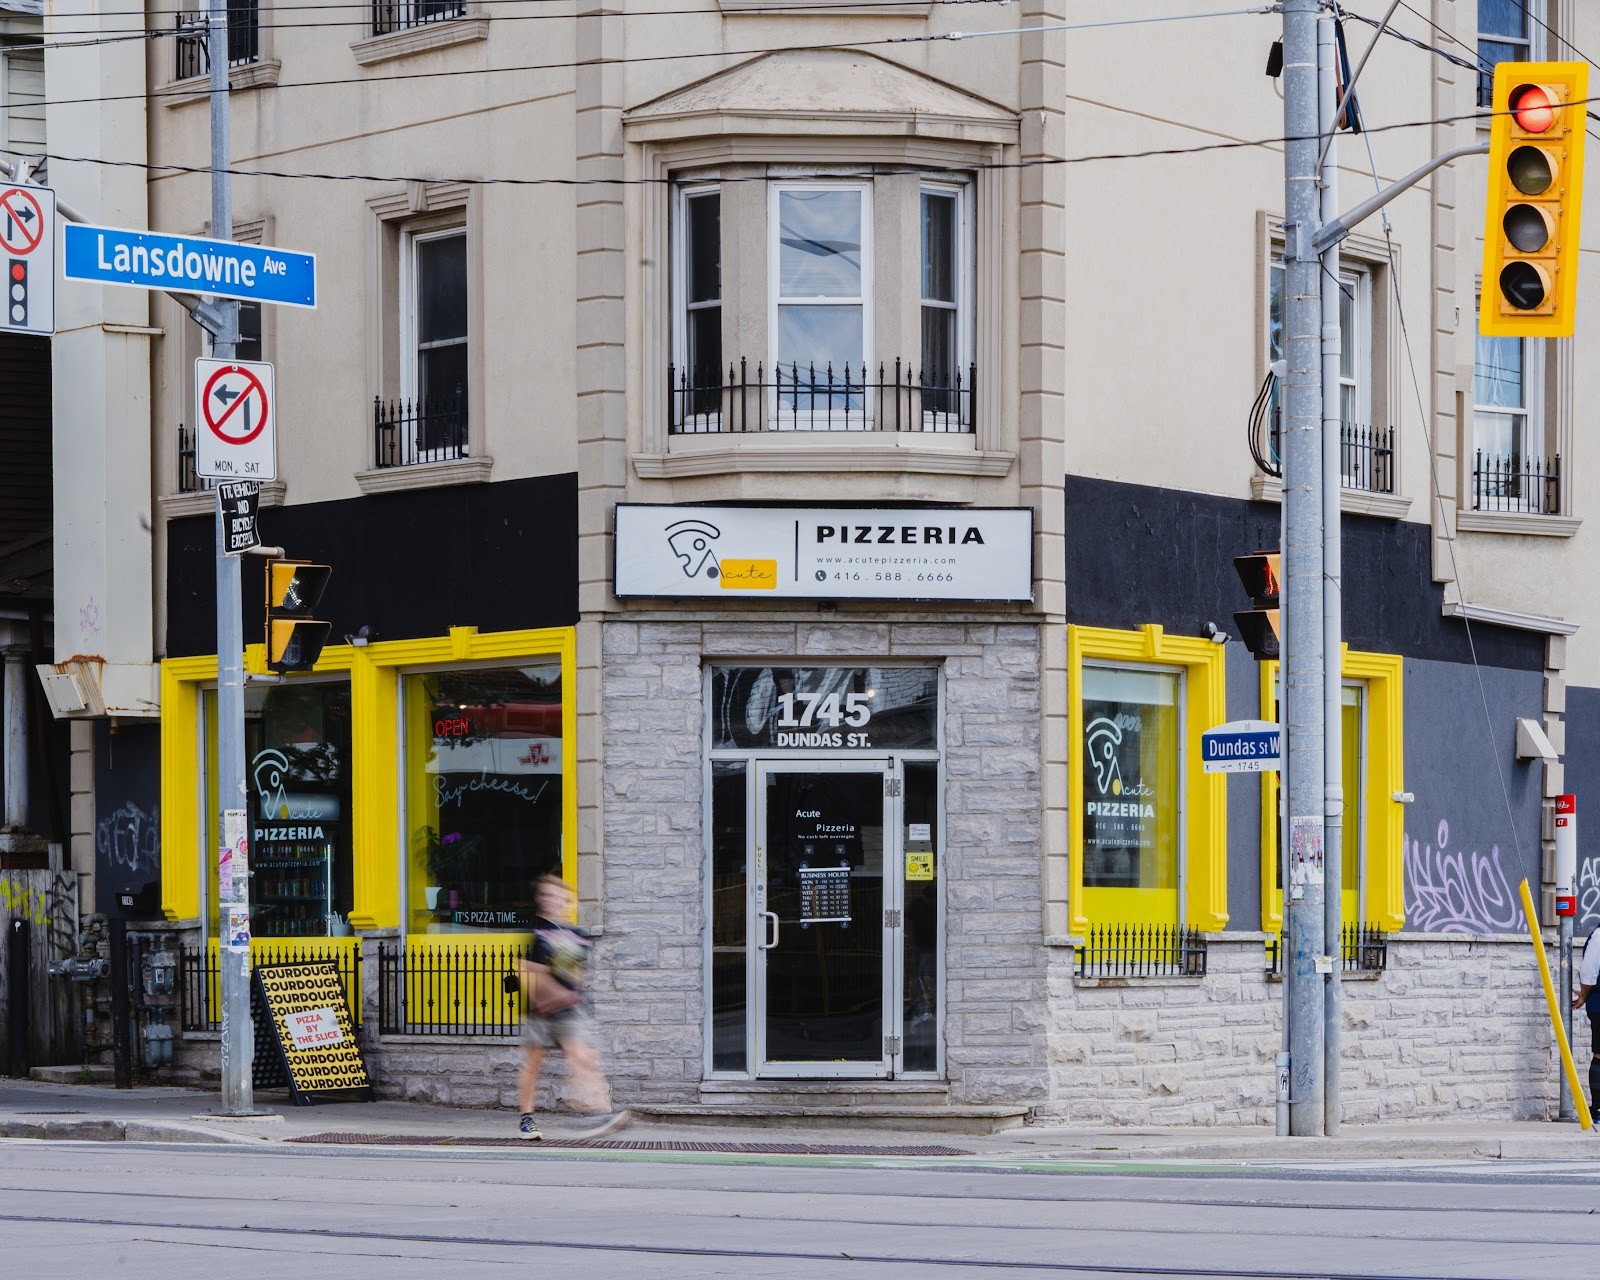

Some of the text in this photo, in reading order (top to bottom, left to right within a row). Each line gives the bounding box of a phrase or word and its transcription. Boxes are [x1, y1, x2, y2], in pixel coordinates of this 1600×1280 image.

[98, 234, 287, 287] Lansdowne Ave
[215, 461, 260, 473] MON SAT
[816, 525, 985, 545] PIZZERIA
[816, 556, 956, 565] www.acutepizzeria.com
[777, 692, 871, 728] 1745
[435, 719, 469, 737] OPEN
[777, 732, 872, 748] DUNDAS ST.
[1209, 736, 1280, 757] Dundas St W
[1238, 761, 1260, 771] 1745
[433, 765, 549, 808] Say cheese!
[795, 809, 821, 818] Acute
[1087, 802, 1155, 818] PIZZERIA
[255, 826, 325, 841] PIZZERIA
[816, 823, 855, 832] Pizzeria
[1087, 838, 1151, 847] www.acutepizzeria.com
[455, 911, 469, 923] IT'S
[471, 911, 495, 923] PIZZA
[260, 966, 337, 980] SOURDOUGH
[264, 978, 342, 993] SOURDOUGH
[268, 990, 345, 1005] SOURDOUGH
[295, 1014, 323, 1025] PIZZA
[306, 1024, 318, 1033] BY
[296, 1035, 314, 1045] THE
[315, 1031, 339, 1043] SLICE
[287, 1052, 361, 1066] SOURDOUGH
[291, 1064, 365, 1078] SOURDOUGH
[295, 1076, 368, 1090] SOURDOUGH
